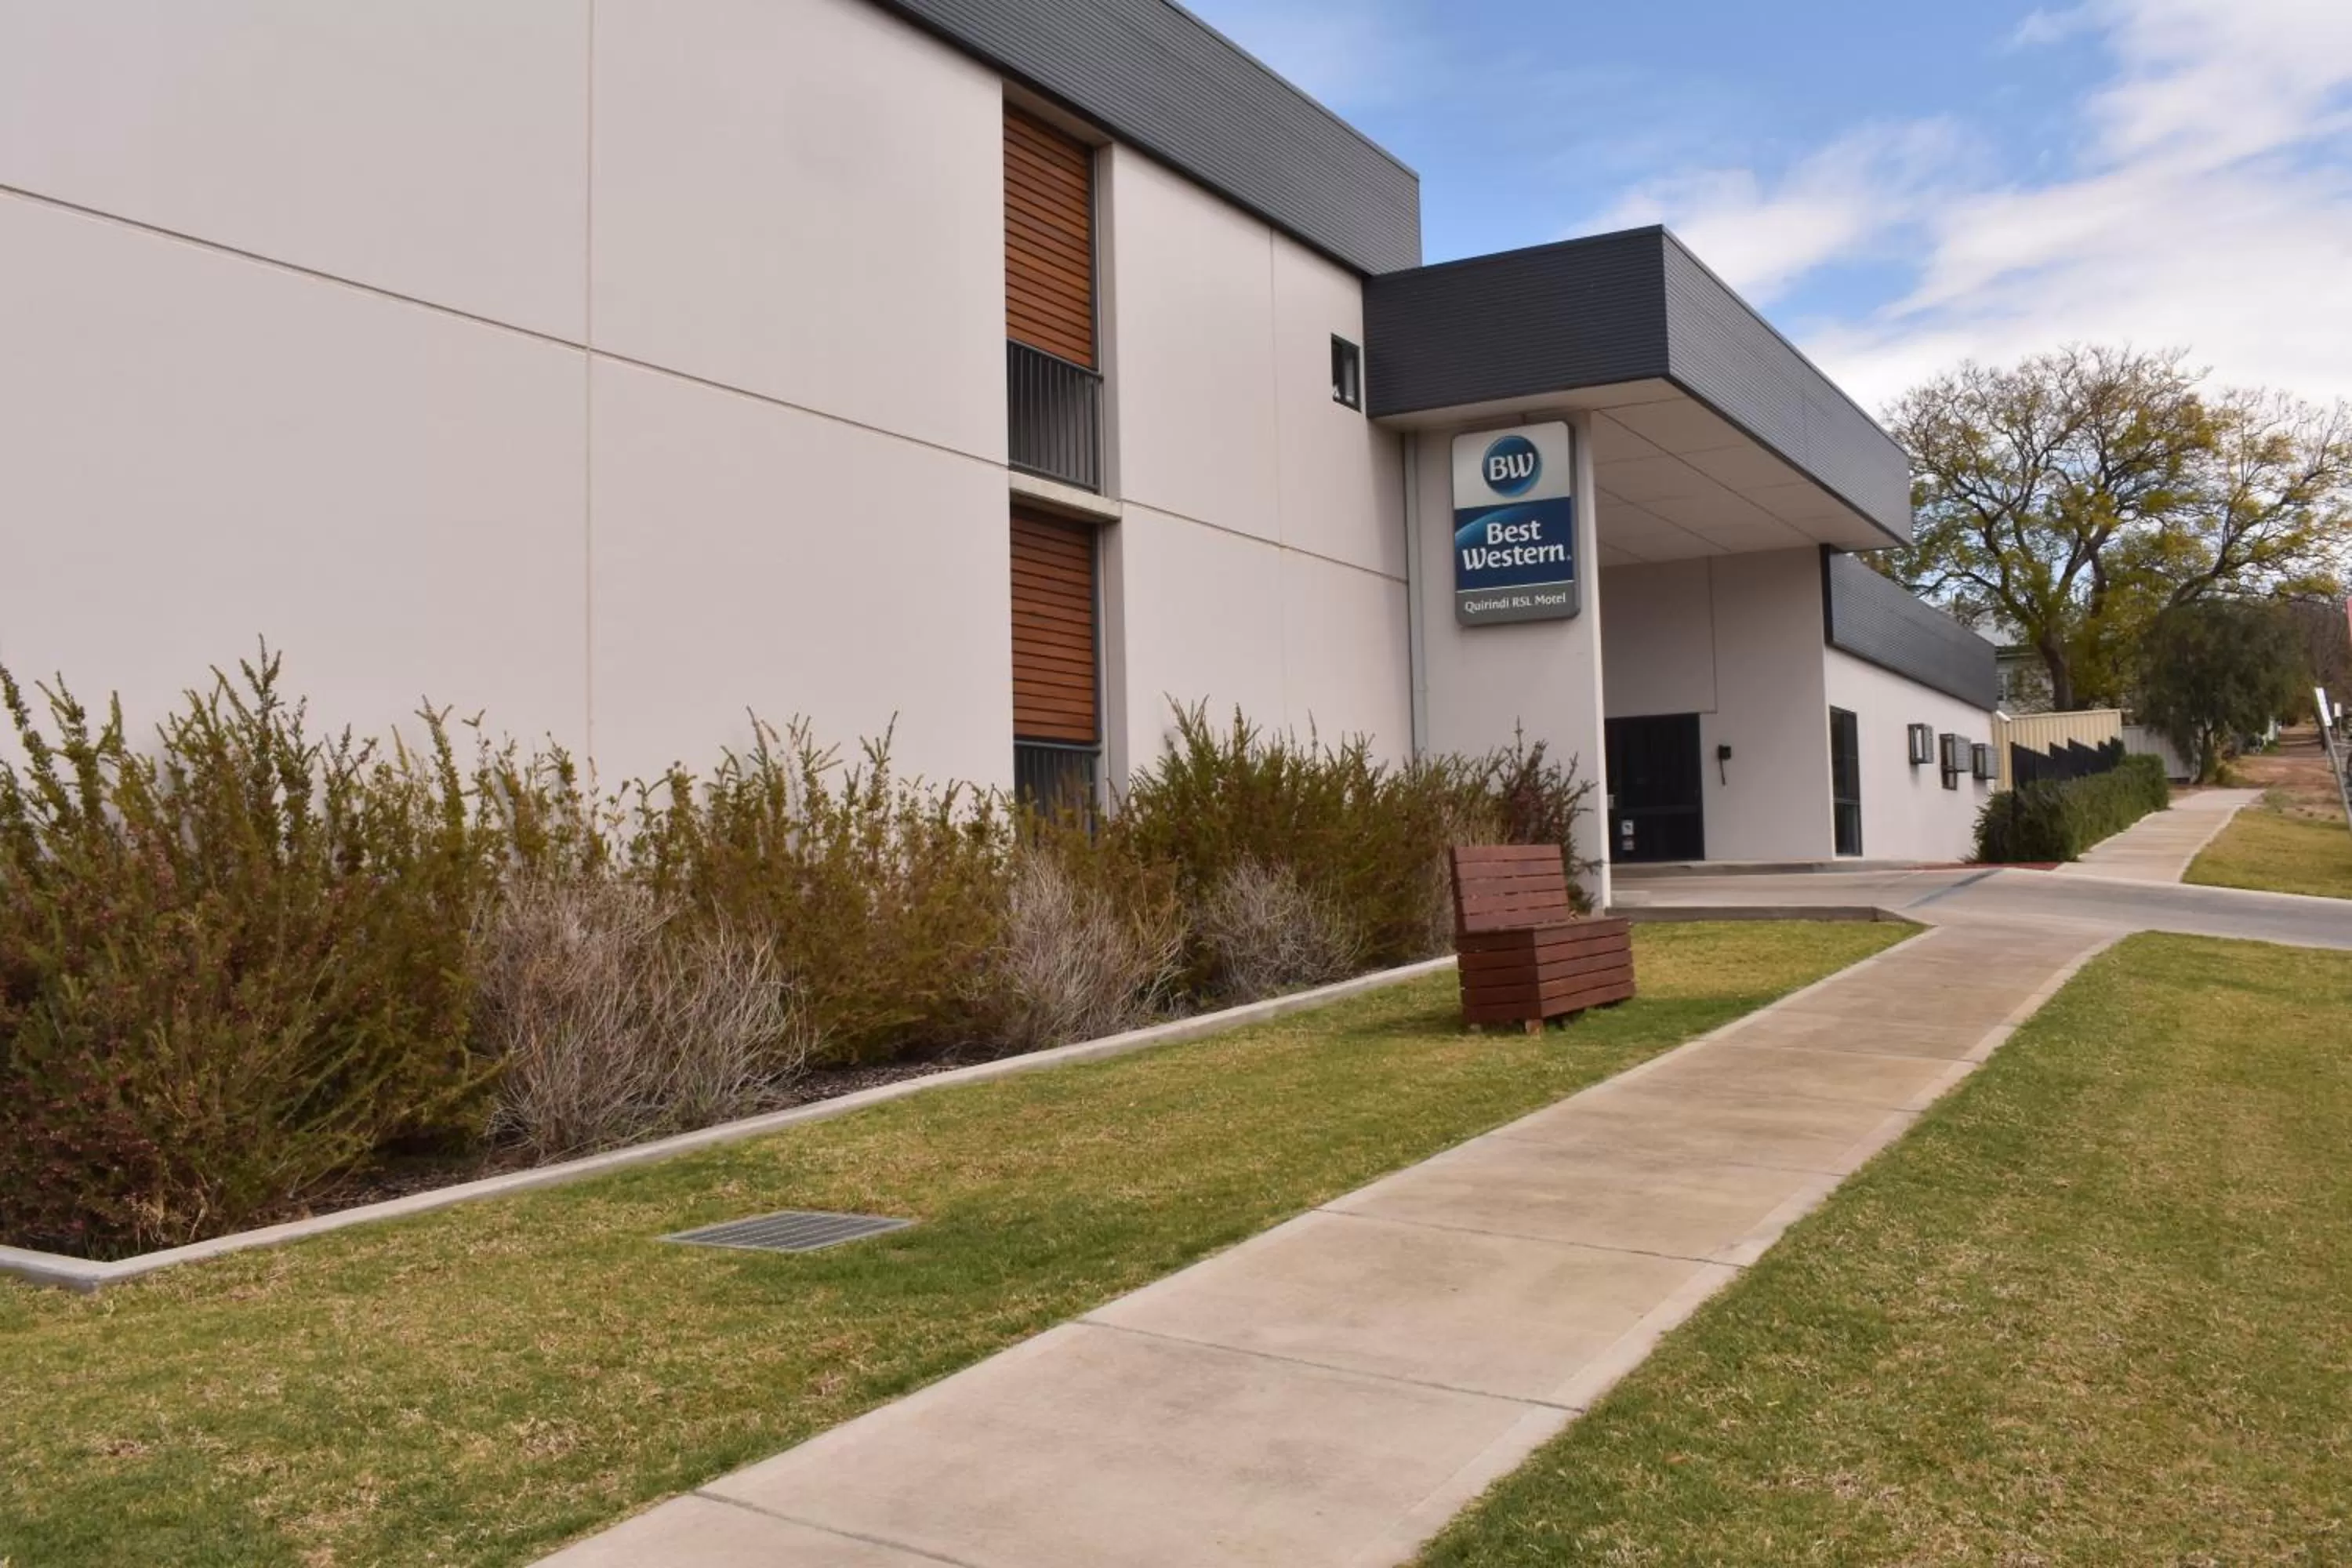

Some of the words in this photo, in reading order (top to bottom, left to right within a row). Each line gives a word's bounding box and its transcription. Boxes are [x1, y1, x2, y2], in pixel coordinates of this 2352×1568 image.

[1489, 452, 1534, 481] BW
[1486, 521, 1541, 545] Best
[1465, 597, 1509, 613] Quirindi
[1512, 595, 1531, 607] RSL
[1534, 592, 1566, 605] Motel
